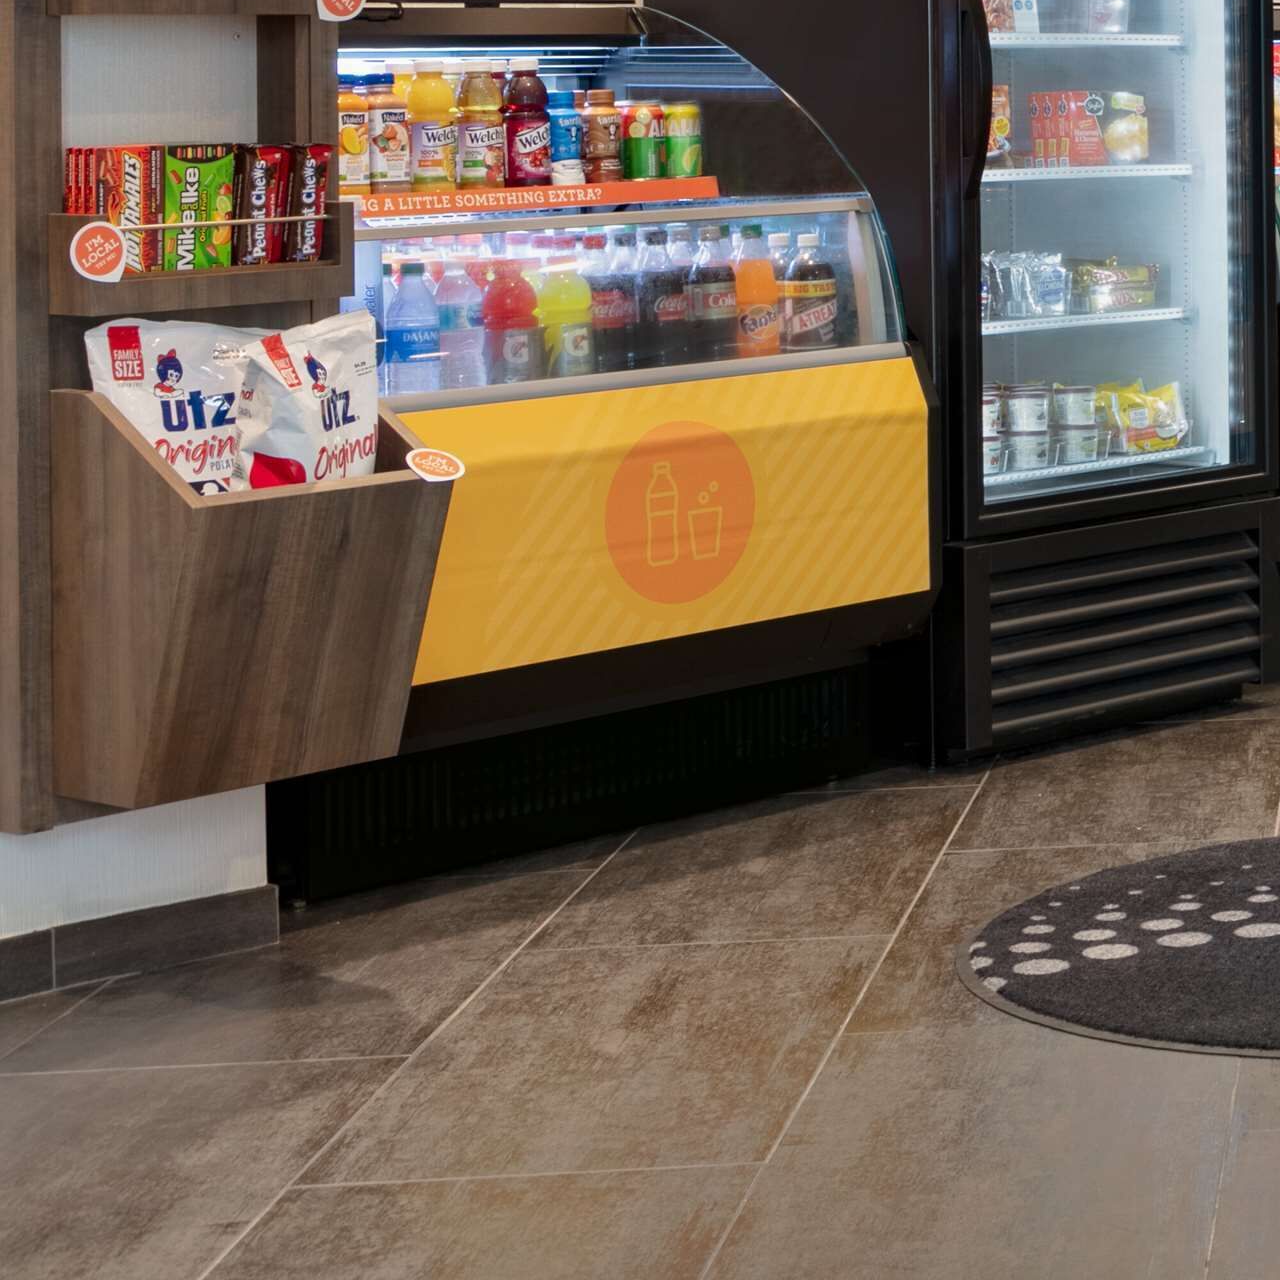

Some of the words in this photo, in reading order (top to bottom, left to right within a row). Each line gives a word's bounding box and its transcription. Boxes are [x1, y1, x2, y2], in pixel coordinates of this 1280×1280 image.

[252, 159, 267, 206] Chews
[302, 155, 317, 204] Chews
[384, 199, 394, 211] A
[400, 196, 452, 210] LITTLE
[455, 192, 545, 207] SOMETHING
[548, 188, 602, 202] EXTRA?
[85, 235, 105, 252] I'M
[175, 208, 196, 271] Mike
[81, 238, 120, 268] LOCAL
[708, 293, 736, 308] Cok
[403, 330, 438, 342] DASAN
[113, 349, 140, 360] FAMILY
[114, 361, 142, 378] SIZE
[154, 434, 237, 475] Origin
